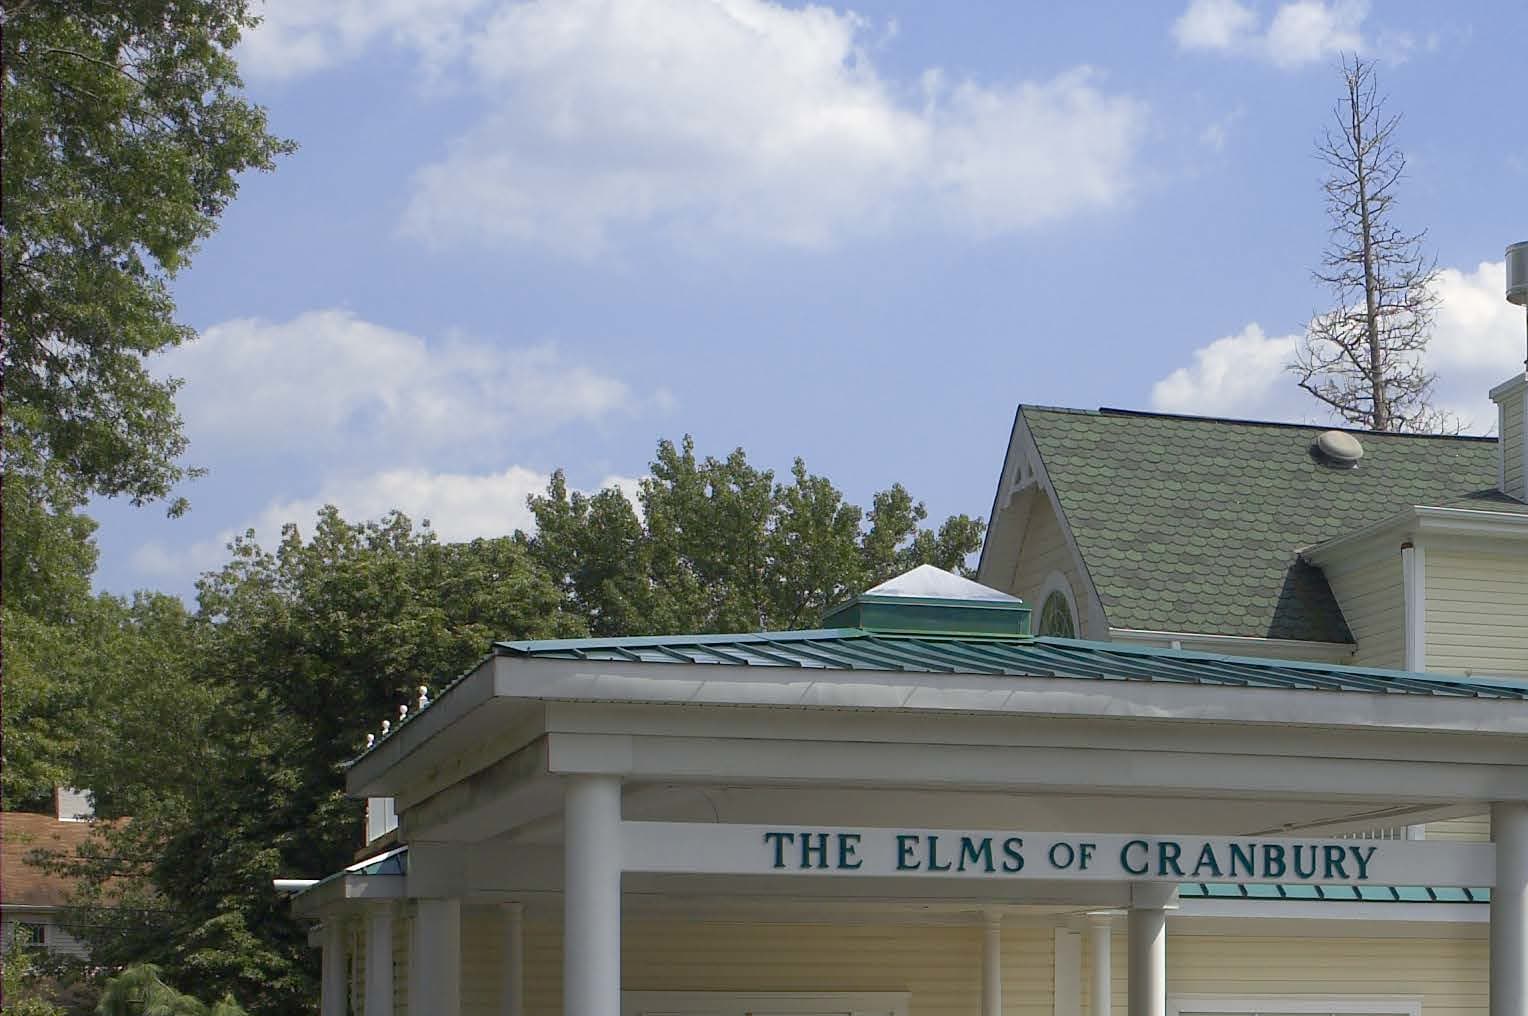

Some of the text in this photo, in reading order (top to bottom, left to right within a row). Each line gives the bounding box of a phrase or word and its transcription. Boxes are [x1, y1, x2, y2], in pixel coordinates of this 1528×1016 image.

[764, 832, 1377, 880] THE ELMS OF CRANBURY
